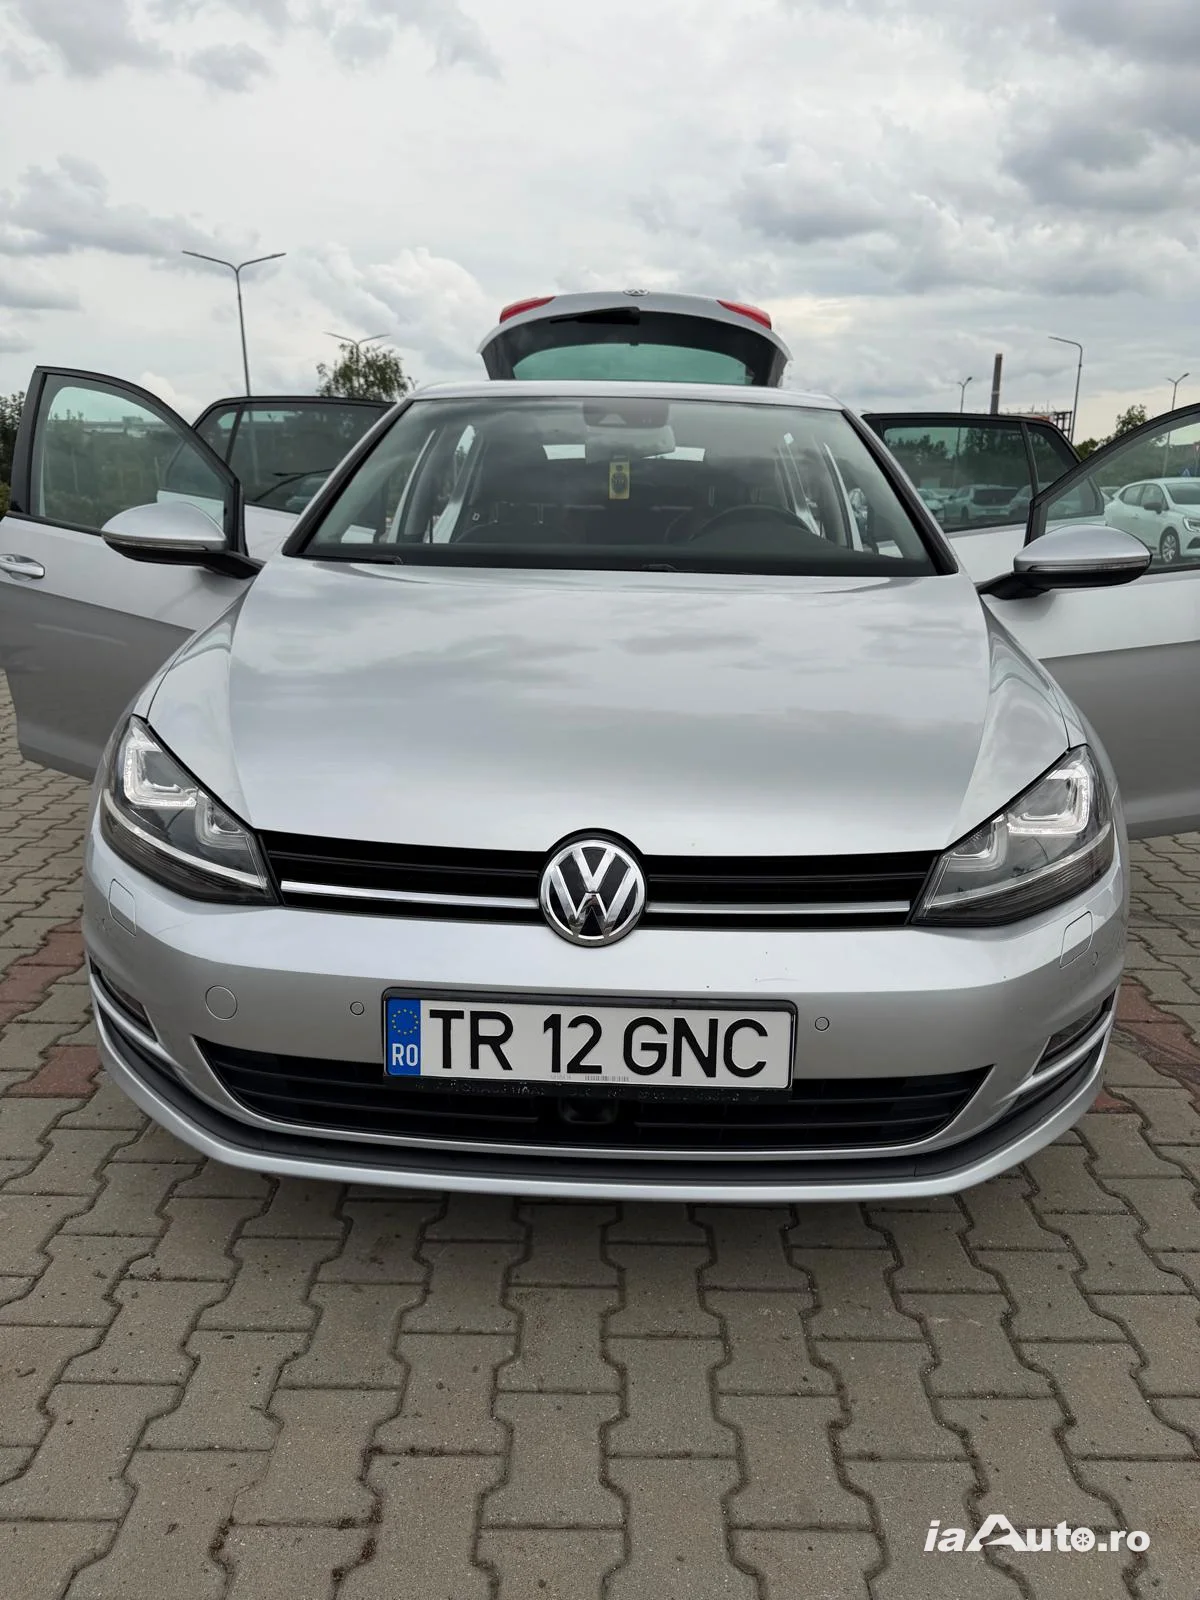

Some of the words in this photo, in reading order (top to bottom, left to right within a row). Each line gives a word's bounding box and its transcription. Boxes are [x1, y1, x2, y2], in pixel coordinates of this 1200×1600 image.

[392, 1043, 419, 1067] RO
[429, 1009, 513, 1071] TR
[543, 1013, 602, 1074] 12
[623, 1016, 768, 1077] GNC
